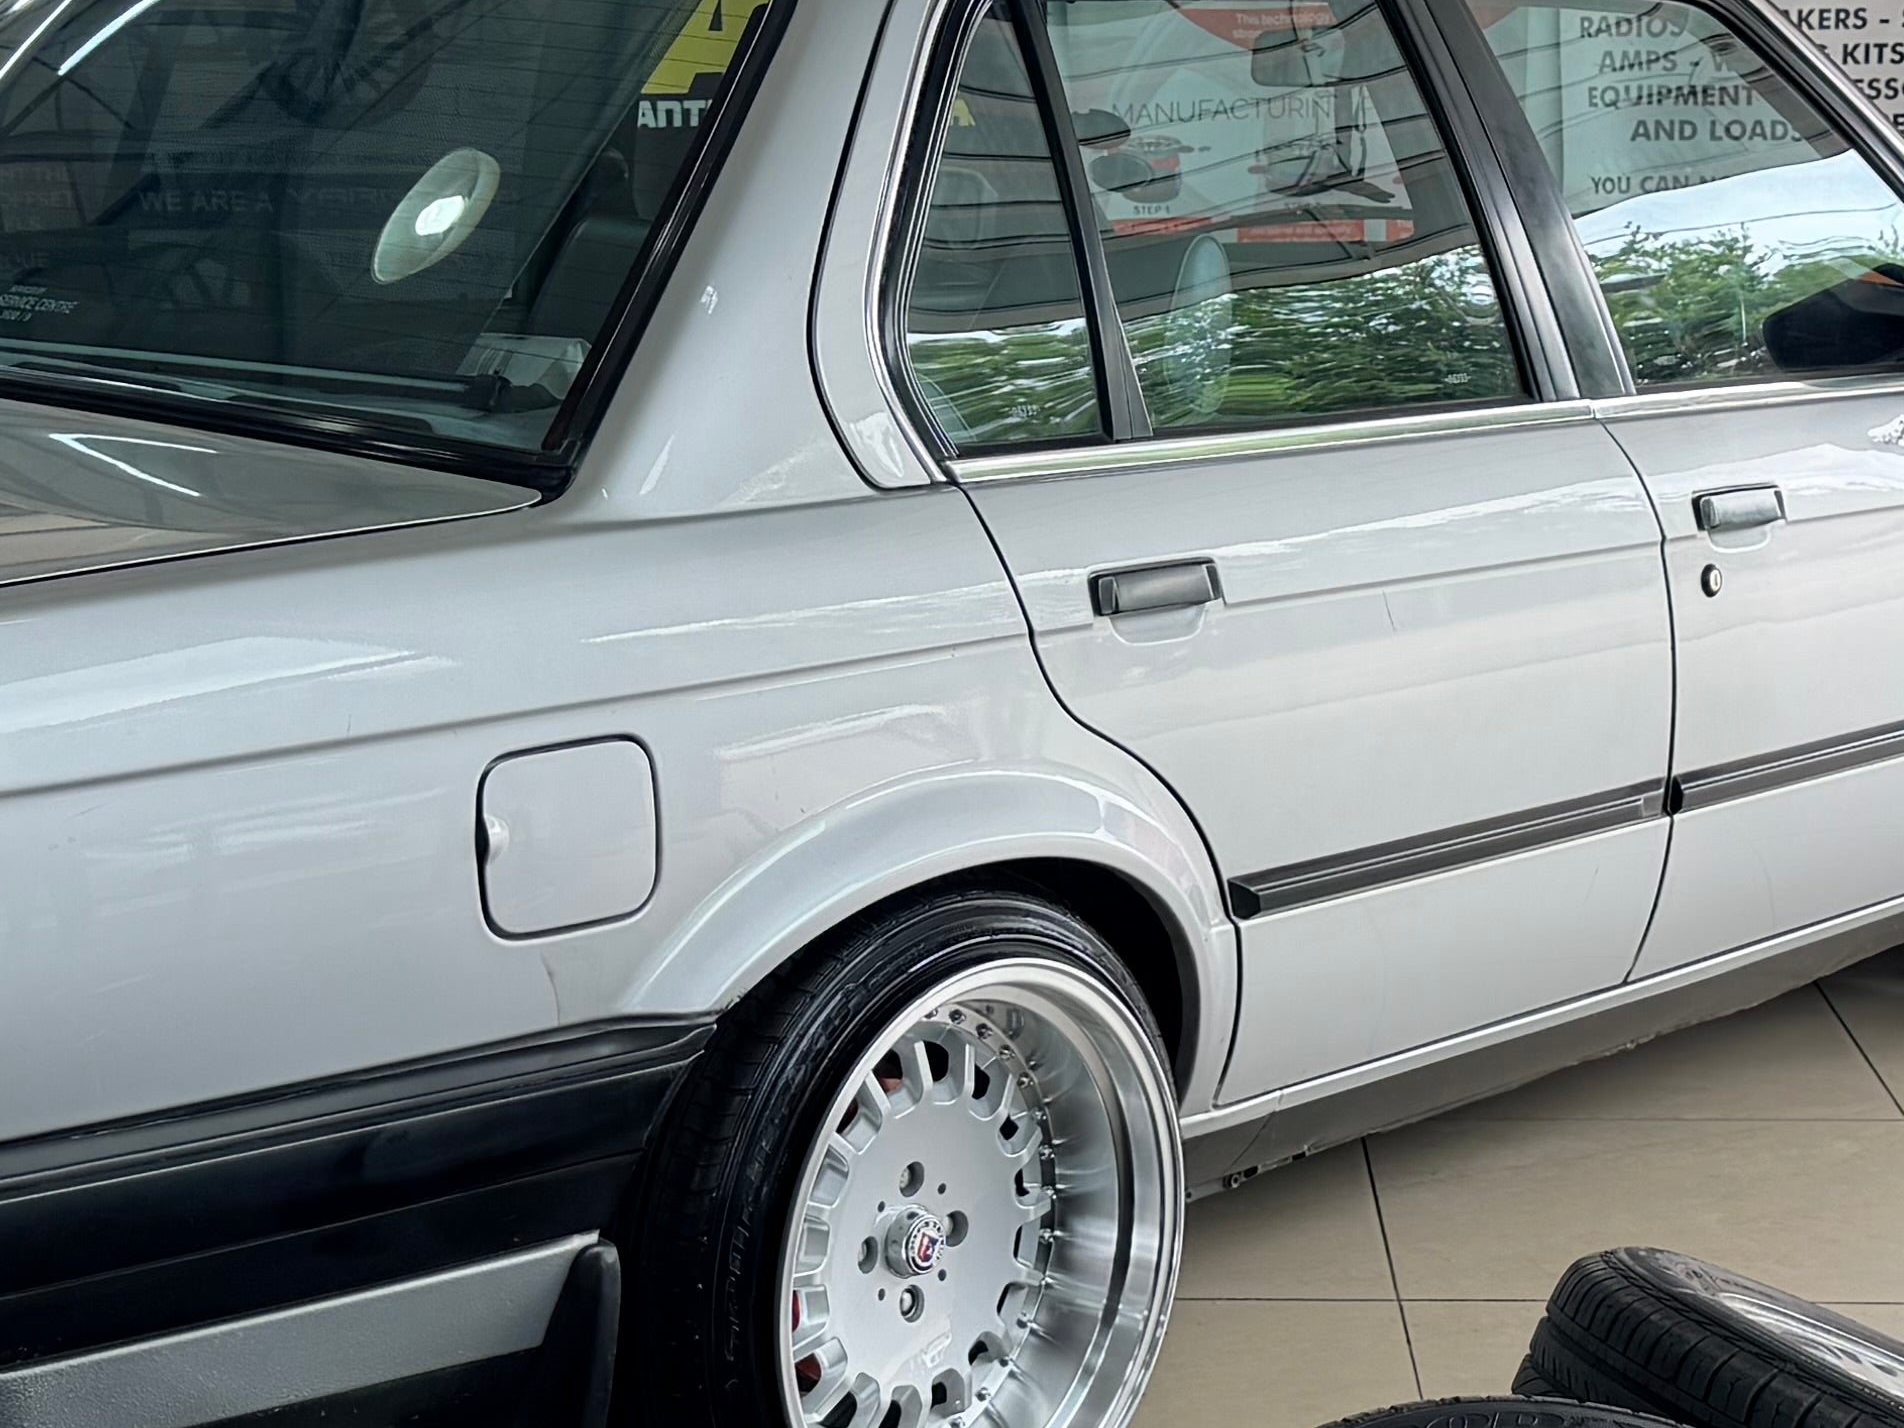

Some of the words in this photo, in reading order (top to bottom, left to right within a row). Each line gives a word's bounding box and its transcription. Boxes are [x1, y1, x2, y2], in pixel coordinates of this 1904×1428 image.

[1599, 51, 1677, 72] AMPS
[1842, 43, 1904, 65] KITS
[1588, 85, 1754, 108] EQUIPMENT
